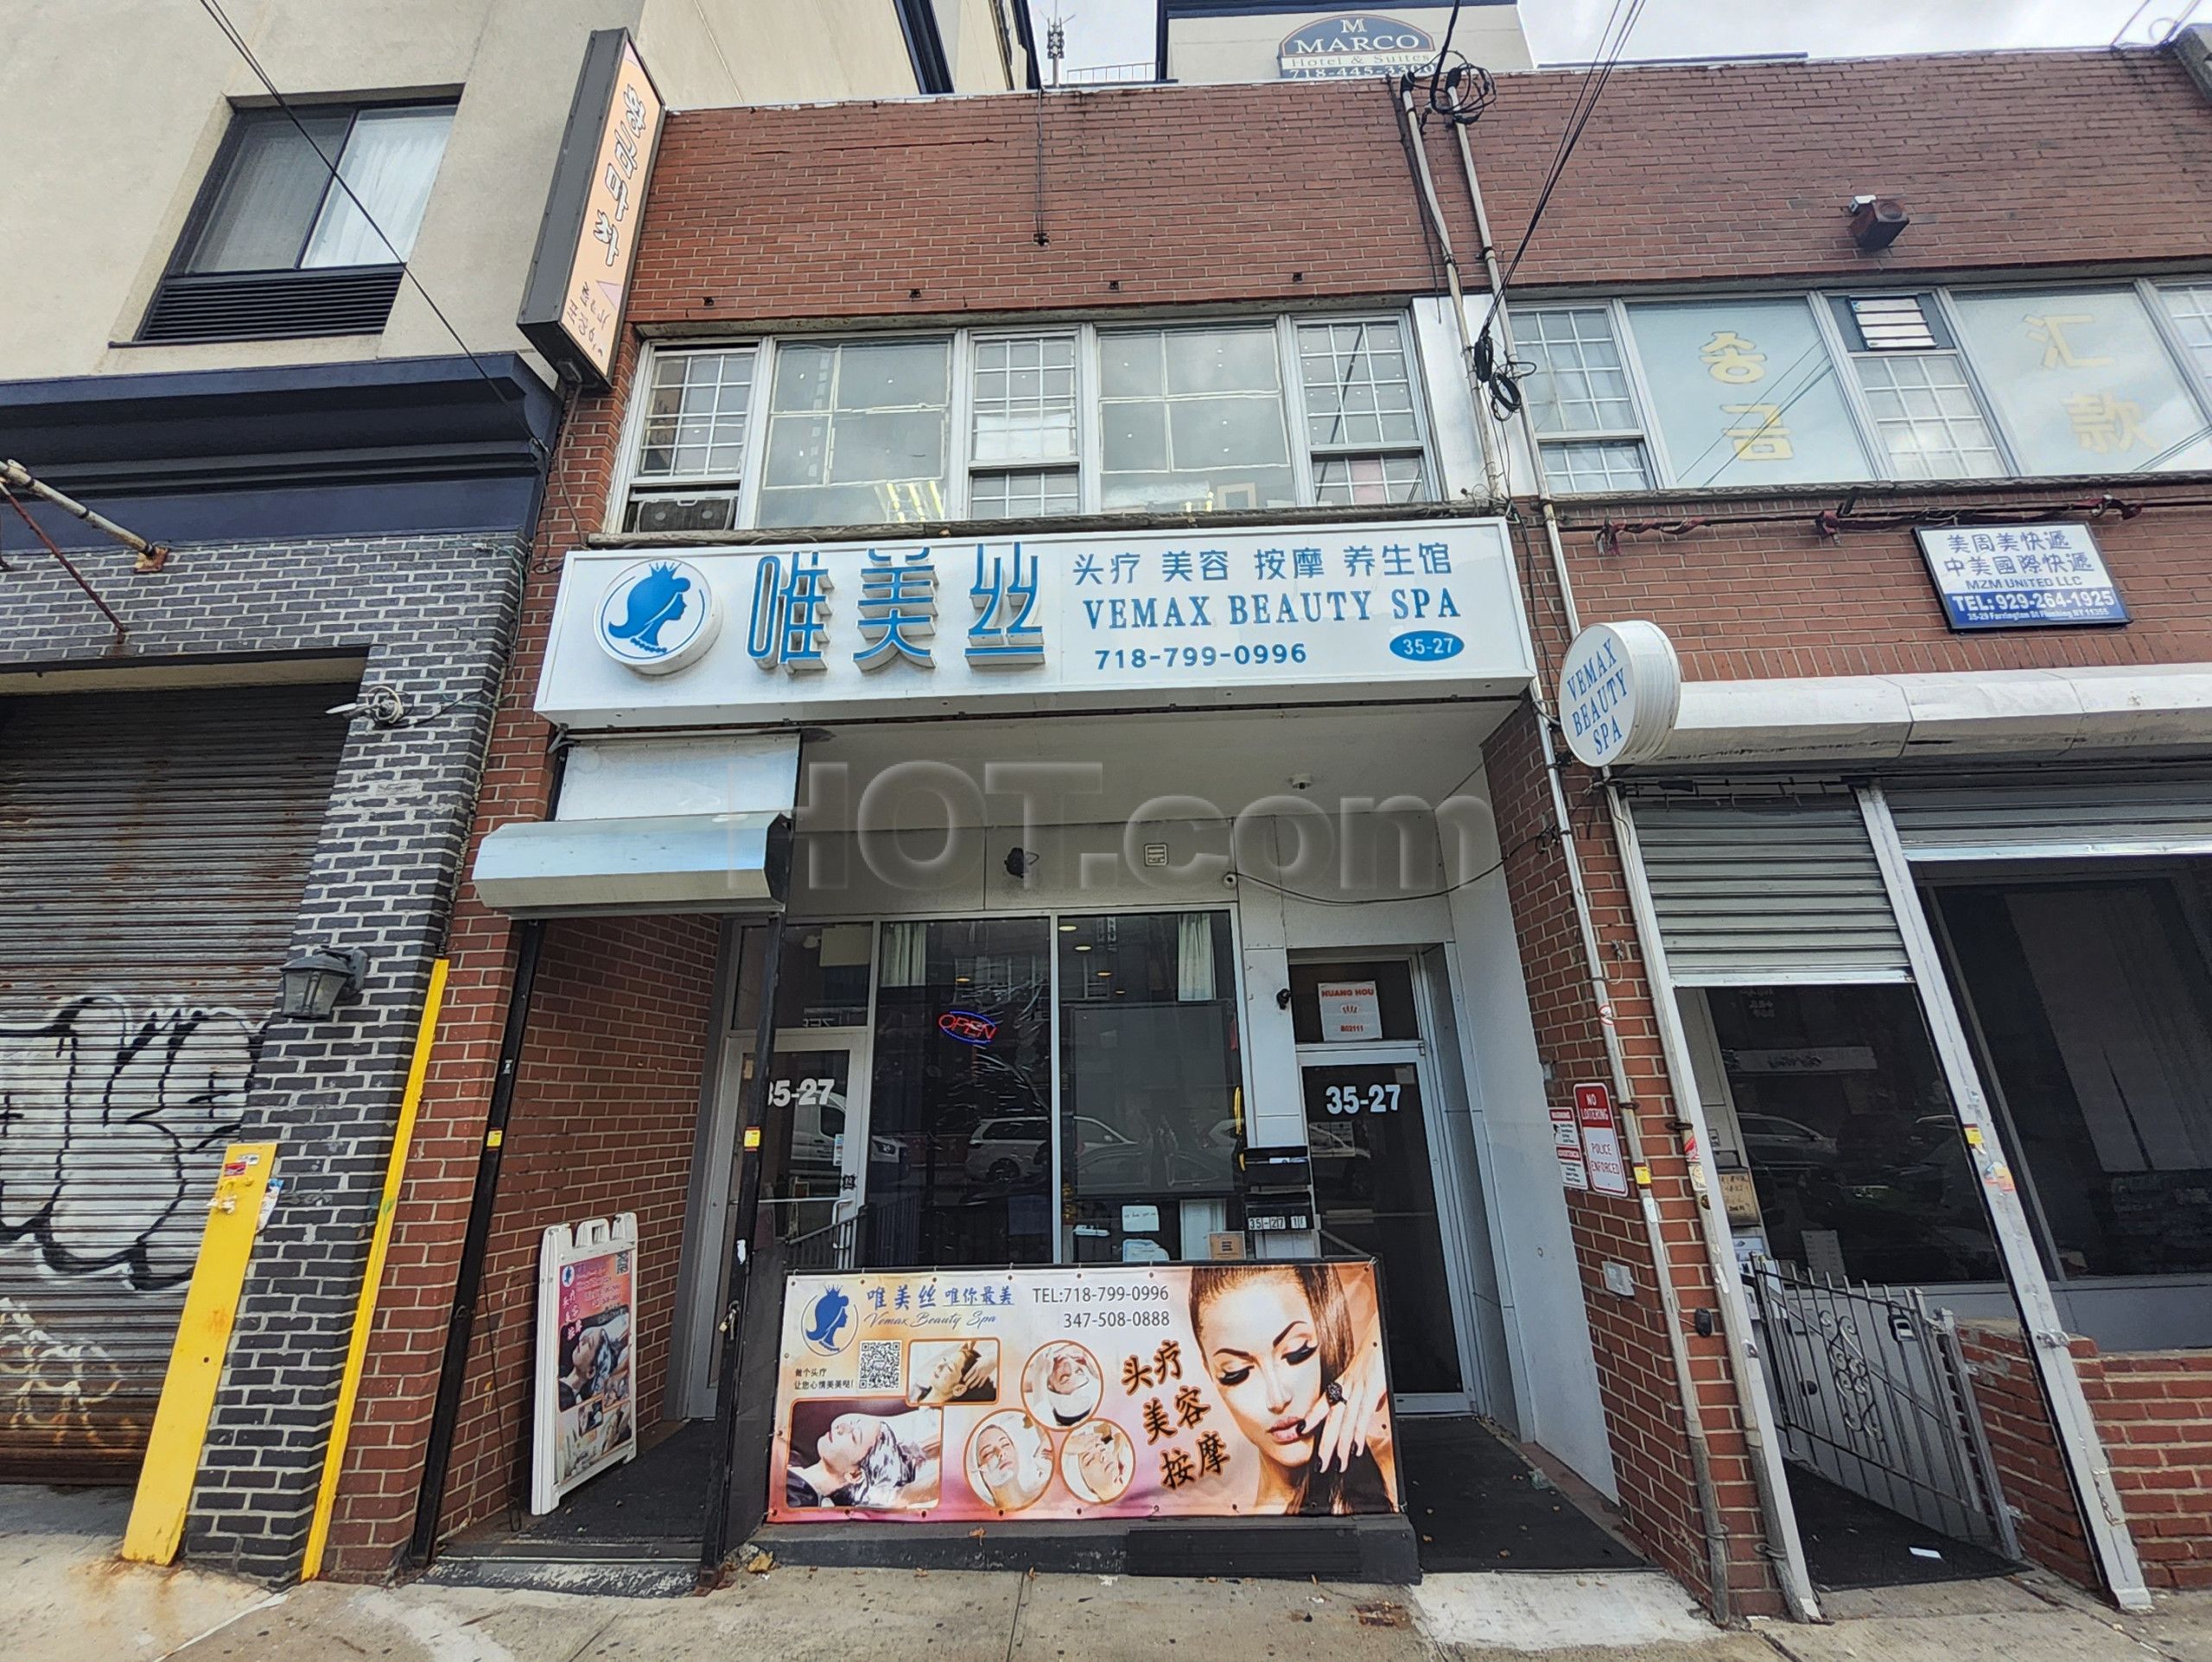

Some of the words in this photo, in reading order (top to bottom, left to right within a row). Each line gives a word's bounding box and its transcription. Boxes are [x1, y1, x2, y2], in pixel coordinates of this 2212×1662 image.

[1340, 17, 1368, 34] M
[1294, 35, 1420, 54] MARCO
[1292, 55, 1342, 67] Hotel
[1351, 55, 1364, 65] &
[1374, 53, 1431, 64] Suites
[1700, 331, 1795, 462] 송금
[2023, 313, 2162, 455] 汇款
[1072, 551, 1141, 586] 头疗
[1162, 548, 1230, 583] 美容
[1254, 545, 1324, 581] 按摩
[1343, 542, 1452, 579] 养生馆
[1966, 578, 2003, 591] MZM
[2006, 577, 2055, 589] UNITED
[2057, 576, 2083, 586] LLC
[1083, 595, 1213, 630] VEMAX
[1228, 589, 1372, 626] BEAUTY
[1393, 587, 1461, 620] SPA
[1952, 595, 1993, 613] TEL:
[1995, 589, 2115, 611] 929-264-1925
[1094, 642, 1307, 671] 718-799-0996
[1402, 636, 1454, 656] 35-27
[1567, 637, 1618, 703] VEMAX
[1571, 666, 1628, 737] BEAUTY
[1592, 714, 1623, 756] SPA
[1354, 988, 1375, 997] HOU
[938, 1014, 997, 1041] OPEN
[1325, 1084, 1402, 1115] 35-27
[1586, 1093, 1597, 1106] NO
[1591, 1142, 1613, 1156] POLICE
[1591, 1161, 1621, 1175] ENFORCED
[1249, 1217, 1284, 1229] 35-27
[867, 1283, 937, 1311] 唯美丝
[944, 1285, 1014, 1306] 唯你最美
[1033, 1285, 1169, 1303] TEL:718-799-0996
[864, 1312, 908, 1328] Vemax
[910, 1312, 962, 1329] Beauty
[966, 1309, 997, 1329] Spa
[1064, 1311, 1170, 1328] 347-508-0888
[1122, 1340, 1183, 1397] 头疗
[1142, 1385, 1211, 1447] 美容
[1160, 1430, 1231, 1491] 按摩
